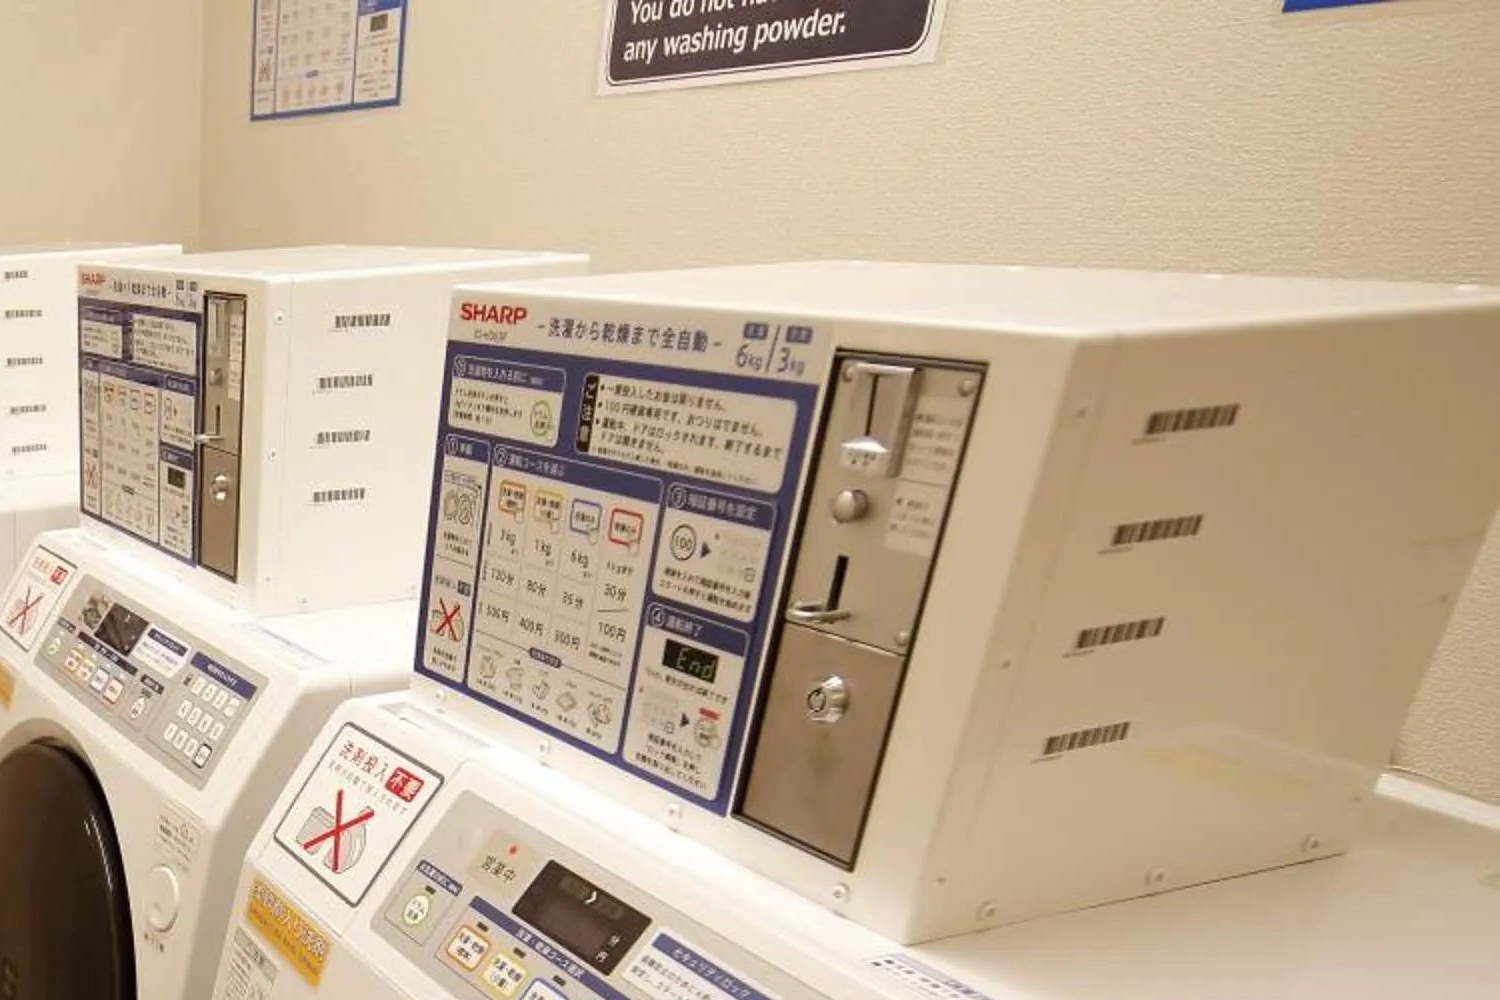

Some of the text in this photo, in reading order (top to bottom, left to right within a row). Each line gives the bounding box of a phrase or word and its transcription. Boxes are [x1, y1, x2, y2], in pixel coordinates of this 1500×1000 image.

[631, 0, 663, 24] You
[669, 0, 694, 18] do
[622, 10, 847, 64] any washing powder.
[459, 302, 527, 326] SHARP
